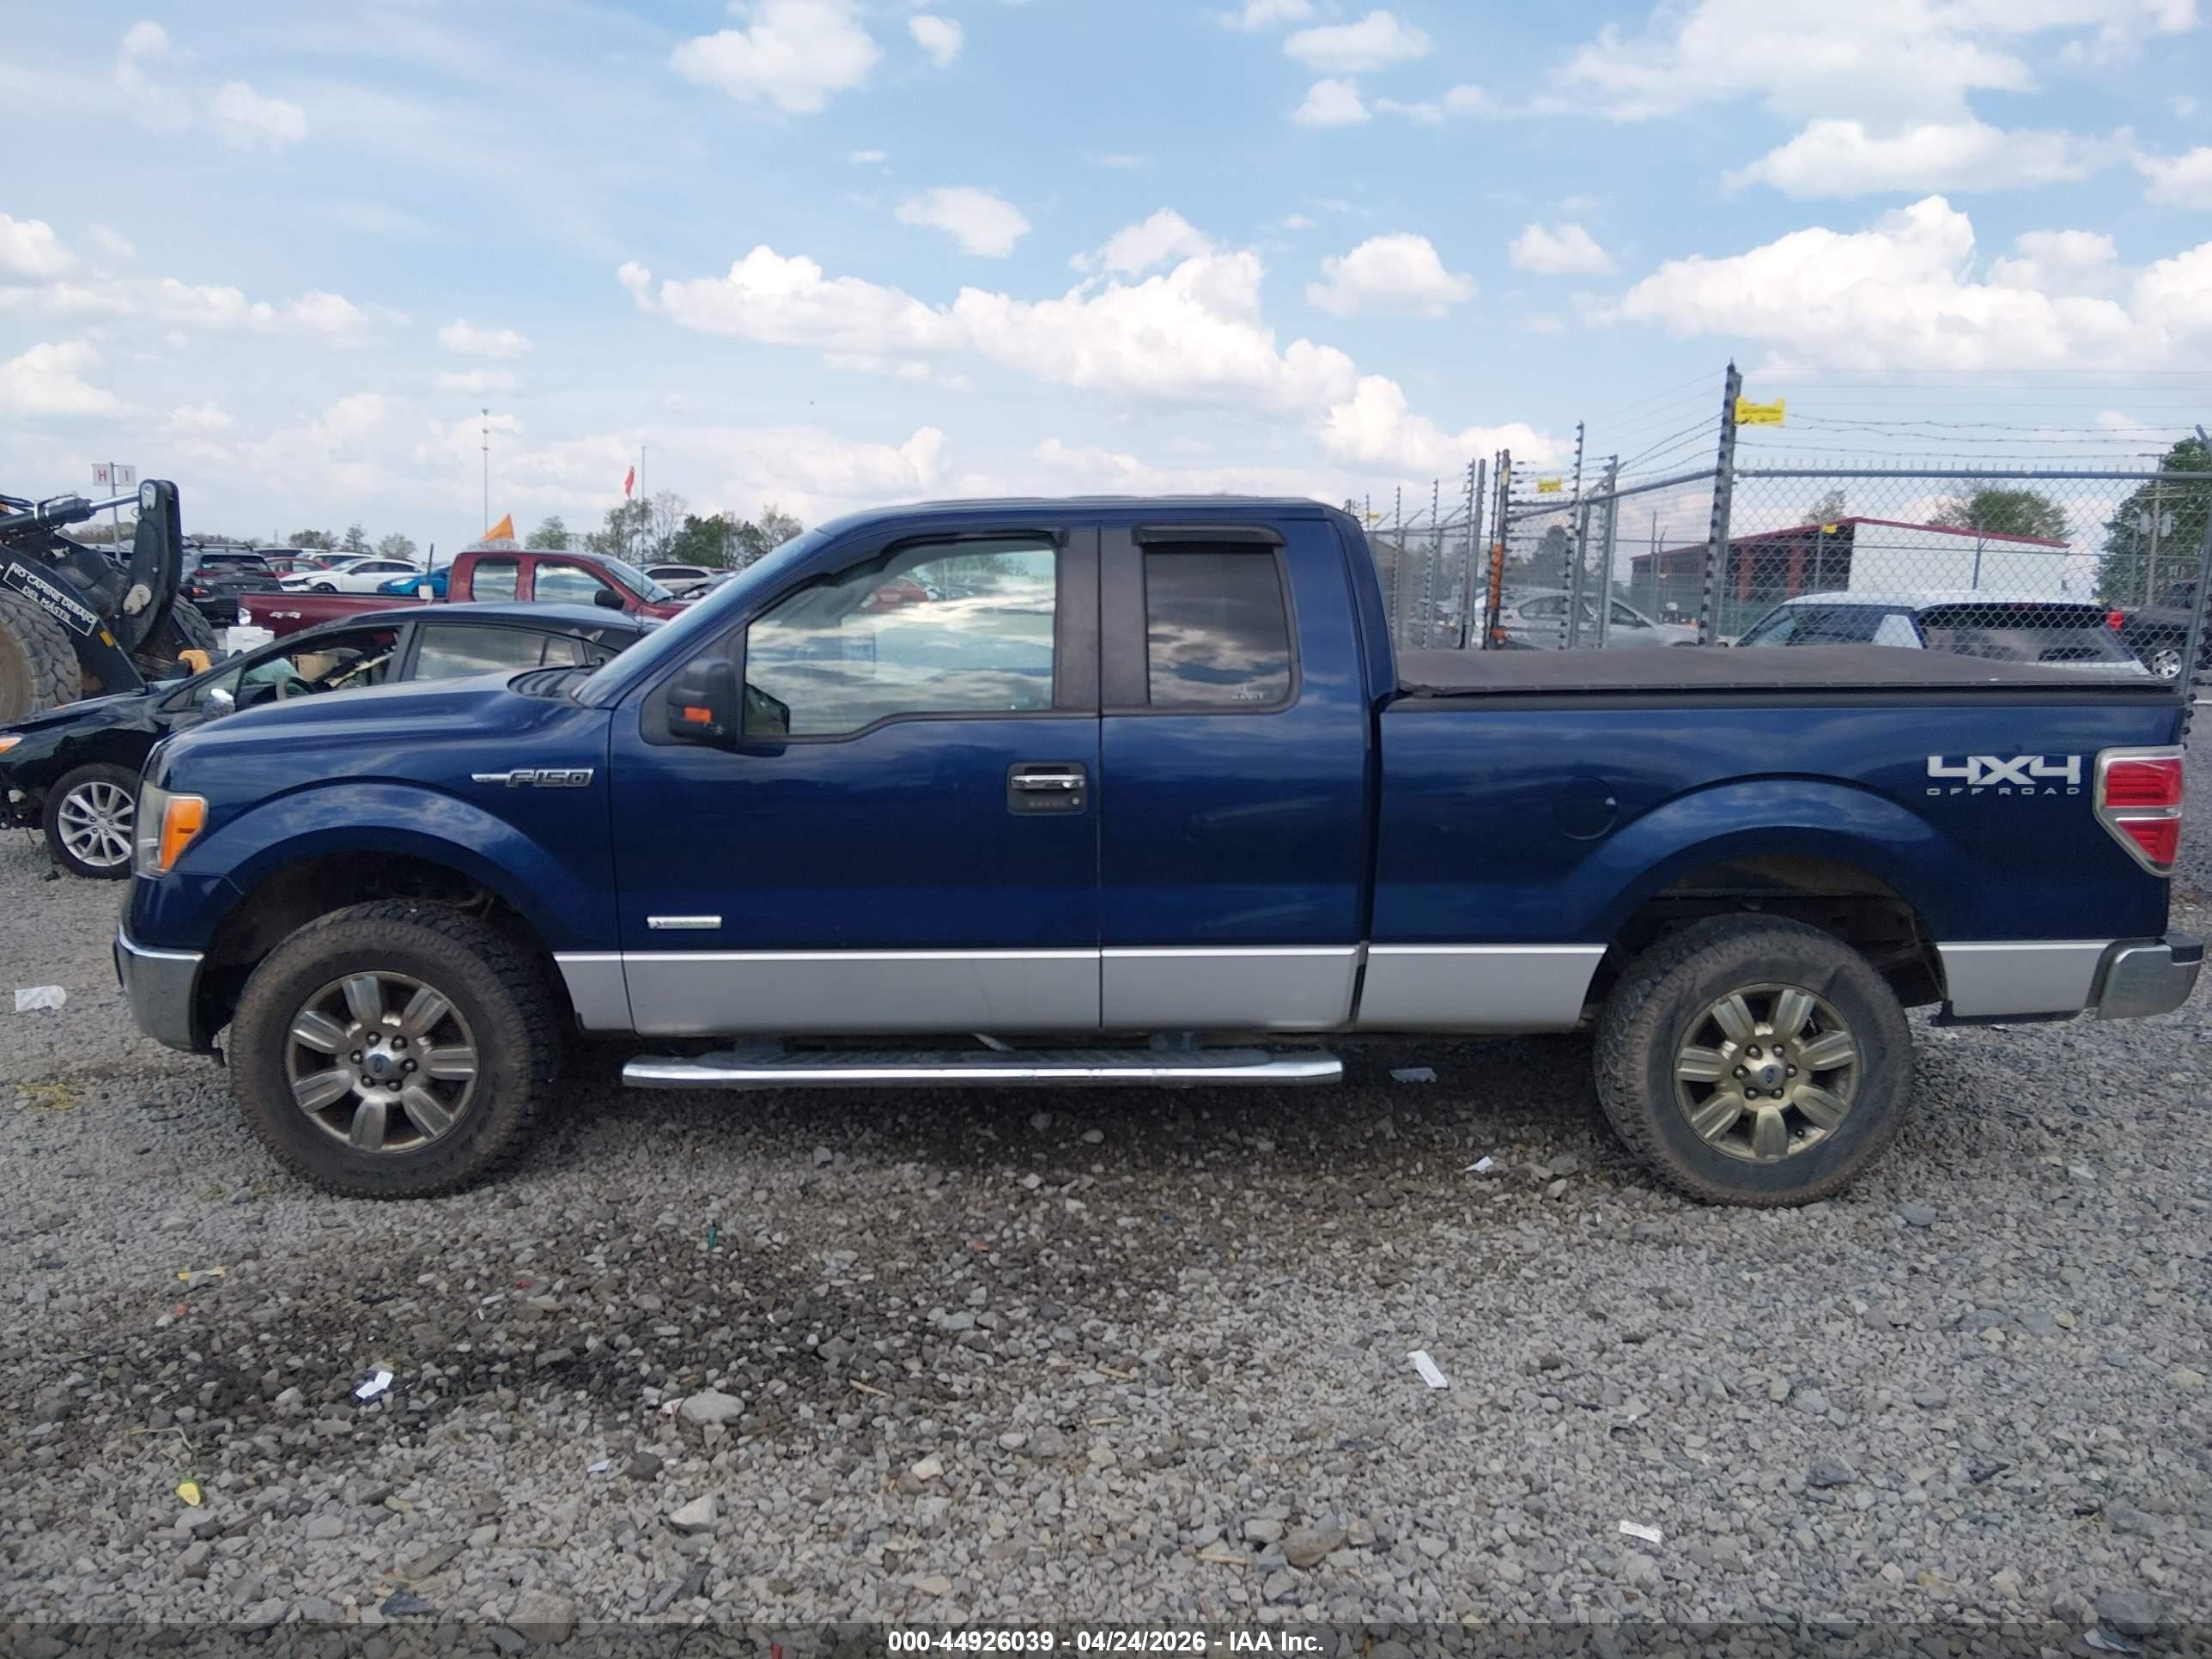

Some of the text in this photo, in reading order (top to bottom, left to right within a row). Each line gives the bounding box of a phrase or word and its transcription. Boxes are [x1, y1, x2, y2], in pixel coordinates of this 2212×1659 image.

[98, 469, 106, 482] H
[10, 563, 27, 578] NO
[25, 574, 62, 602] CAMINE
[21, 585, 41, 601] DEL
[1927, 756, 2081, 785] 4X4
[1926, 787, 1984, 796] OFF
